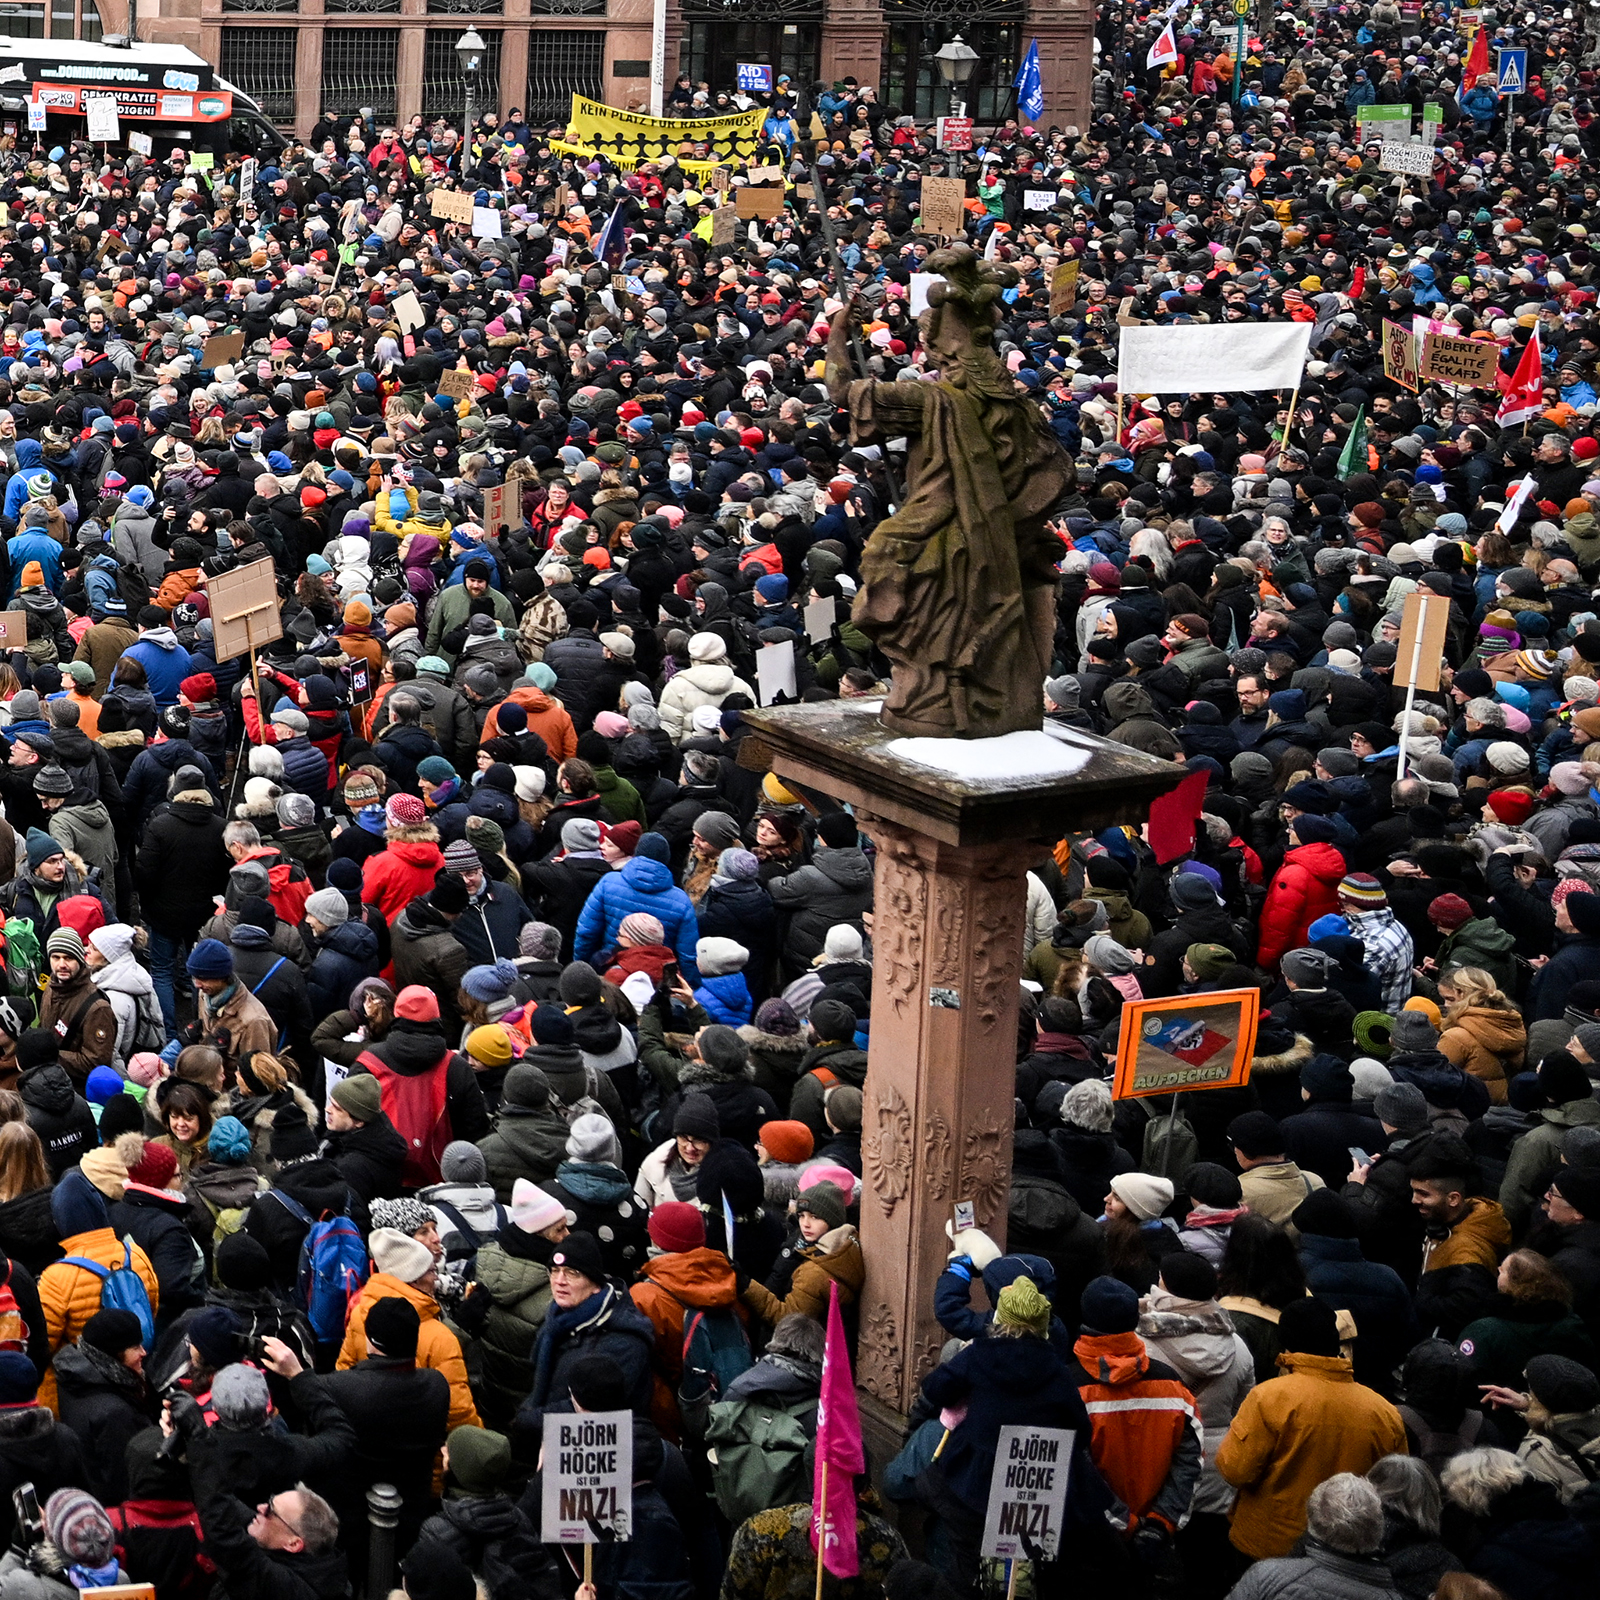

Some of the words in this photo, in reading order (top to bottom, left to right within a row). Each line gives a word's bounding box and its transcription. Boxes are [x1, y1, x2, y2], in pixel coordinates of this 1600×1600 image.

[1238, 0, 1246, 8] H
[81, 104, 155, 115] VDIGEN!
[580, 102, 607, 118] KEIN
[611, 111, 648, 126] PLATZ
[680, 115, 756, 130] RASSISMUS!
[1382, 147, 1433, 161] FASCHISTEN
[1432, 337, 1483, 355] LIBERTÉ
[1431, 351, 1489, 369] ÉGALITÉ
[1132, 1065, 1230, 1091] AUFDECKEN
[559, 1420, 618, 1448] BJÖRN
[559, 1448, 618, 1476] HÖCKE
[1009, 1434, 1060, 1463] BJÖRN
[576, 1476, 589, 1486] IST
[1004, 1461, 1055, 1491] HÖCKE
[559, 1486, 618, 1523] NAZI
[996, 1501, 1052, 1538] NAZI
